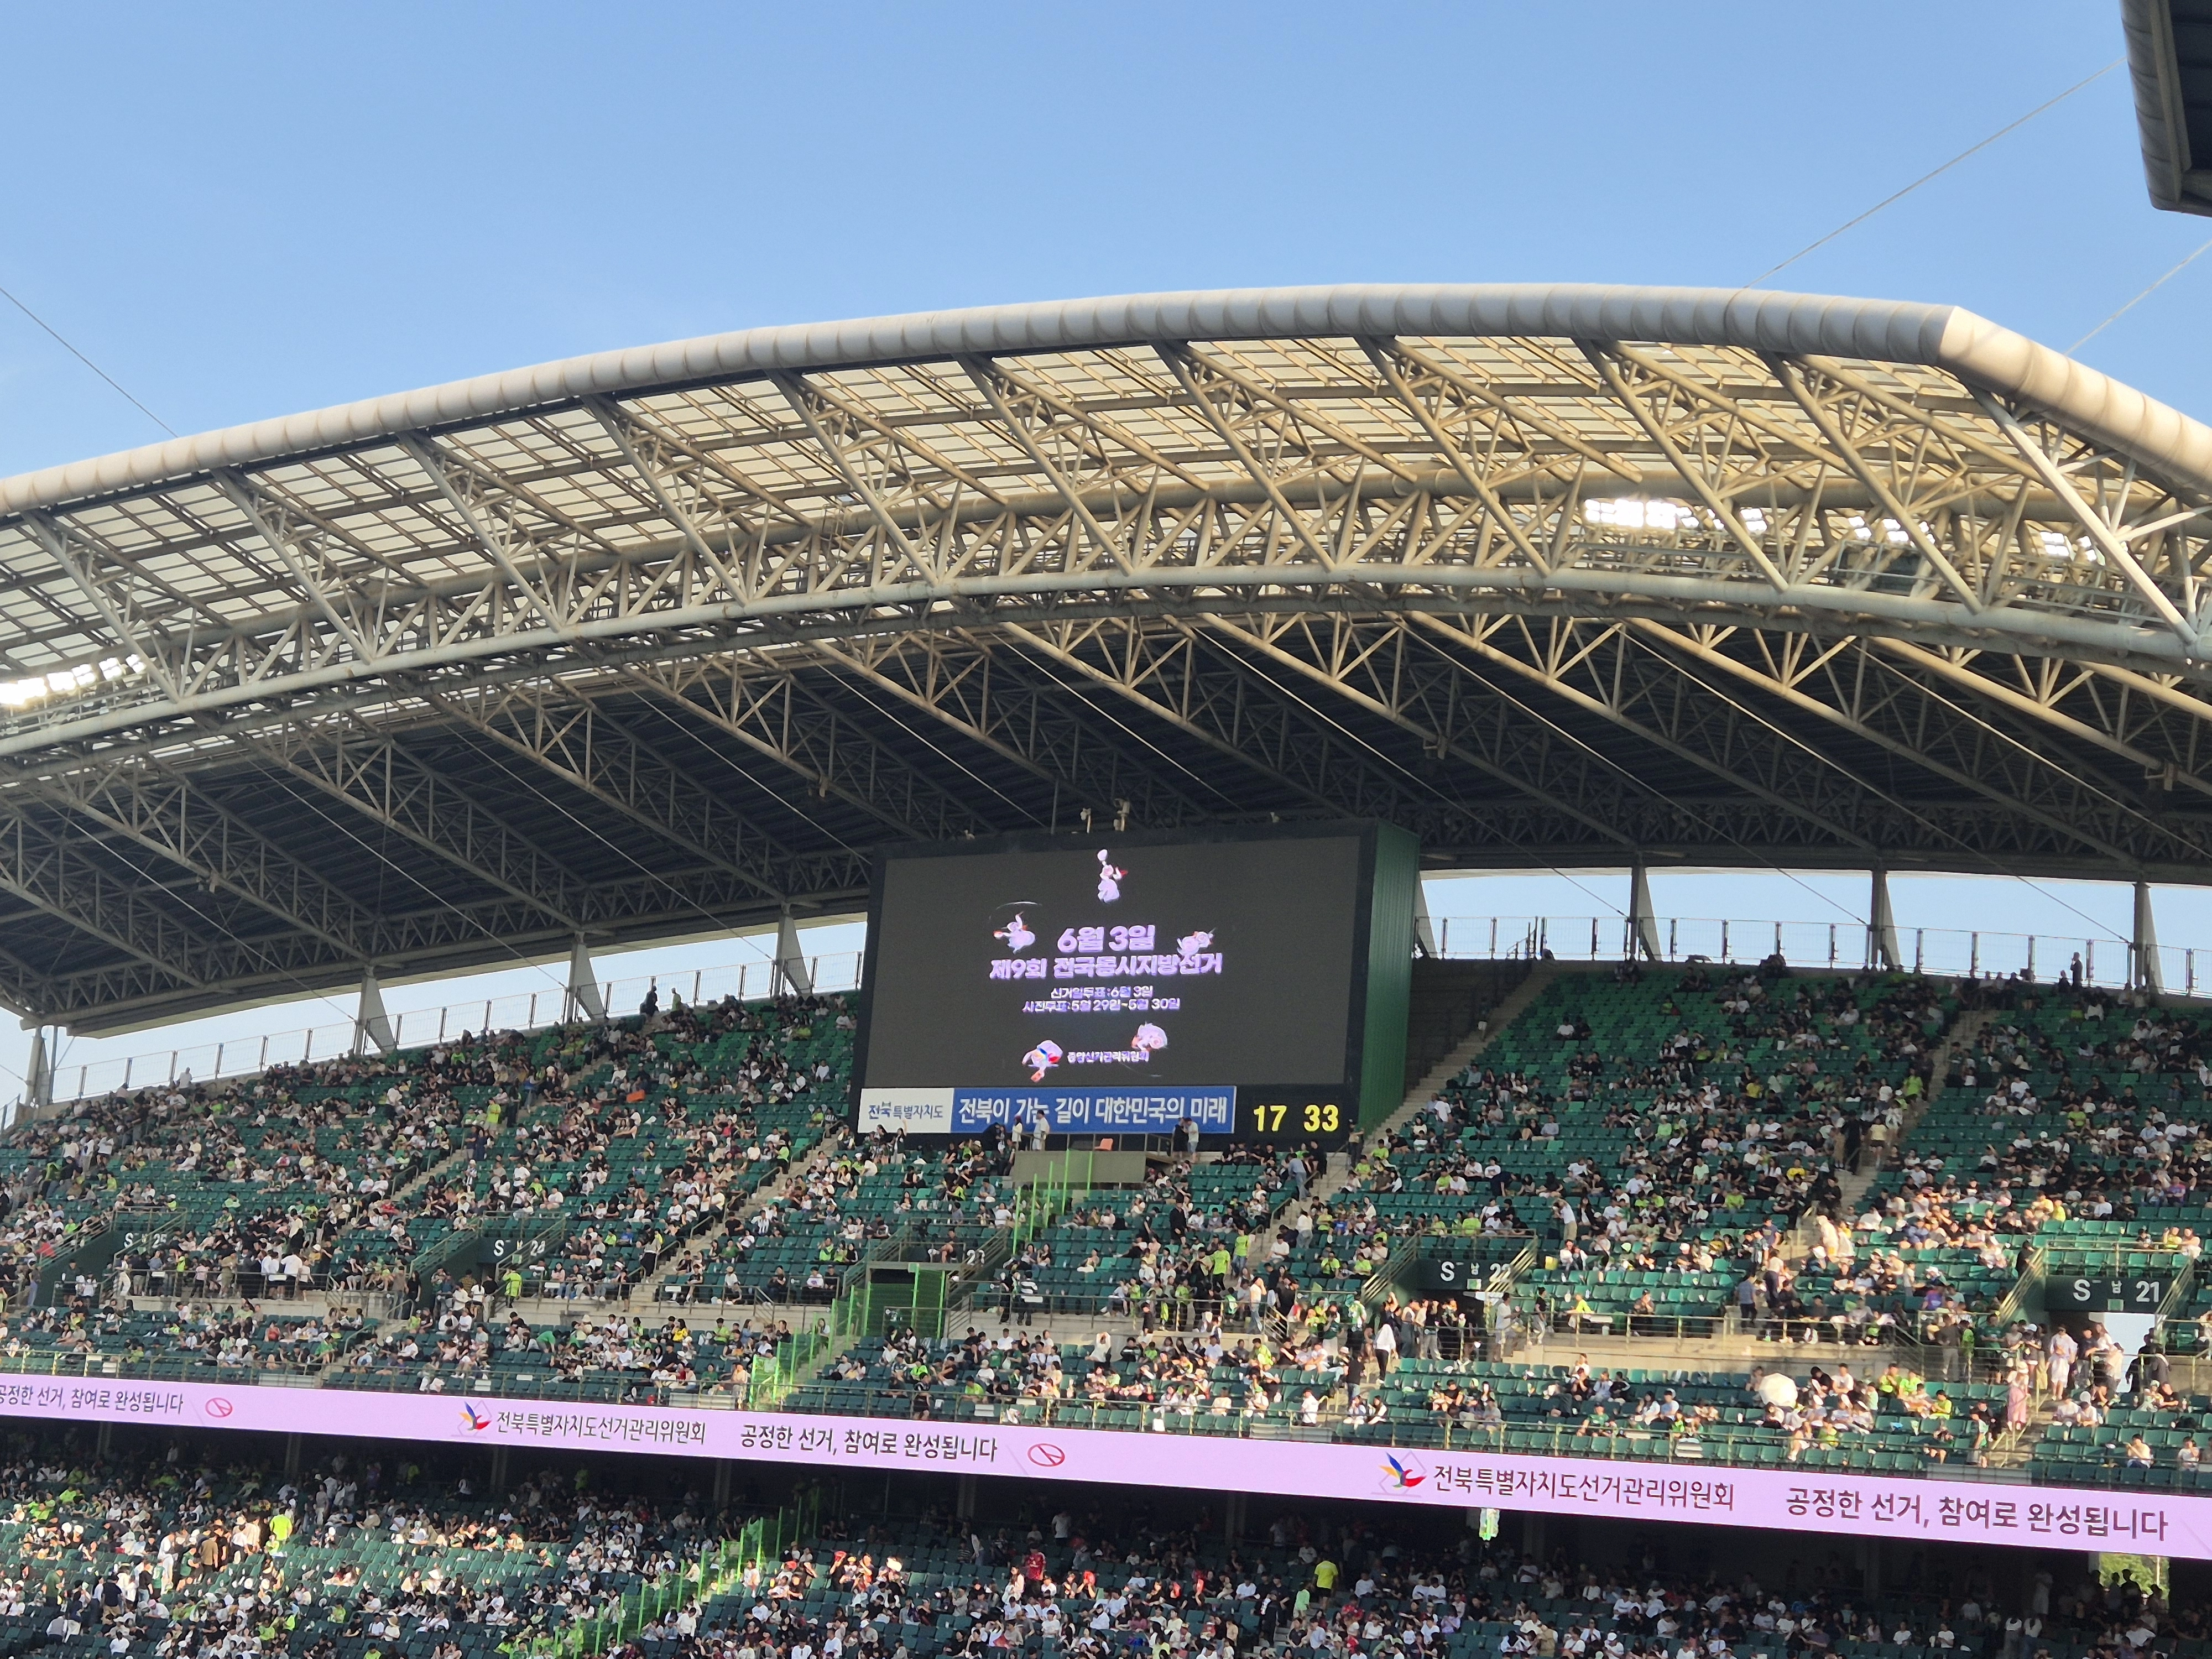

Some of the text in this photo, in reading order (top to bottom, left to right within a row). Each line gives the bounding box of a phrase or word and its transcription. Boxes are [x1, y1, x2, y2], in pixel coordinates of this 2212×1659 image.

[1057, 924, 1156, 953] 6월 3일
[989, 958, 1048, 980] 제9회
[959, 1098, 1009, 1124] 전북이
[1055, 1097, 1090, 1123] 길이
[1095, 1097, 1185, 1124] 대한민국의
[1190, 1097, 1227, 1124] 미래
[1253, 1104, 1339, 1132] 17 33
[124, 1233, 133, 1249] S
[493, 1239, 504, 1256] S
[1440, 1261, 1455, 1281] S
[2073, 1279, 2091, 1301] S
[2136, 1280, 2160, 1302] 21
[71, 1389, 110, 1409] 참여로
[115, 1391, 184, 1413] 완성됩니다
[497, 1411, 706, 1444] 전북특별자치도선거관리위원회
[741, 1425, 998, 1463] 공정한 선거, 참여로 완성됩니다
[1433, 1464, 1735, 1511] 전북특별자치도선거관리위원회
[1786, 1488, 2169, 1542] 공정한 선거, 참여로 완성됩니다
